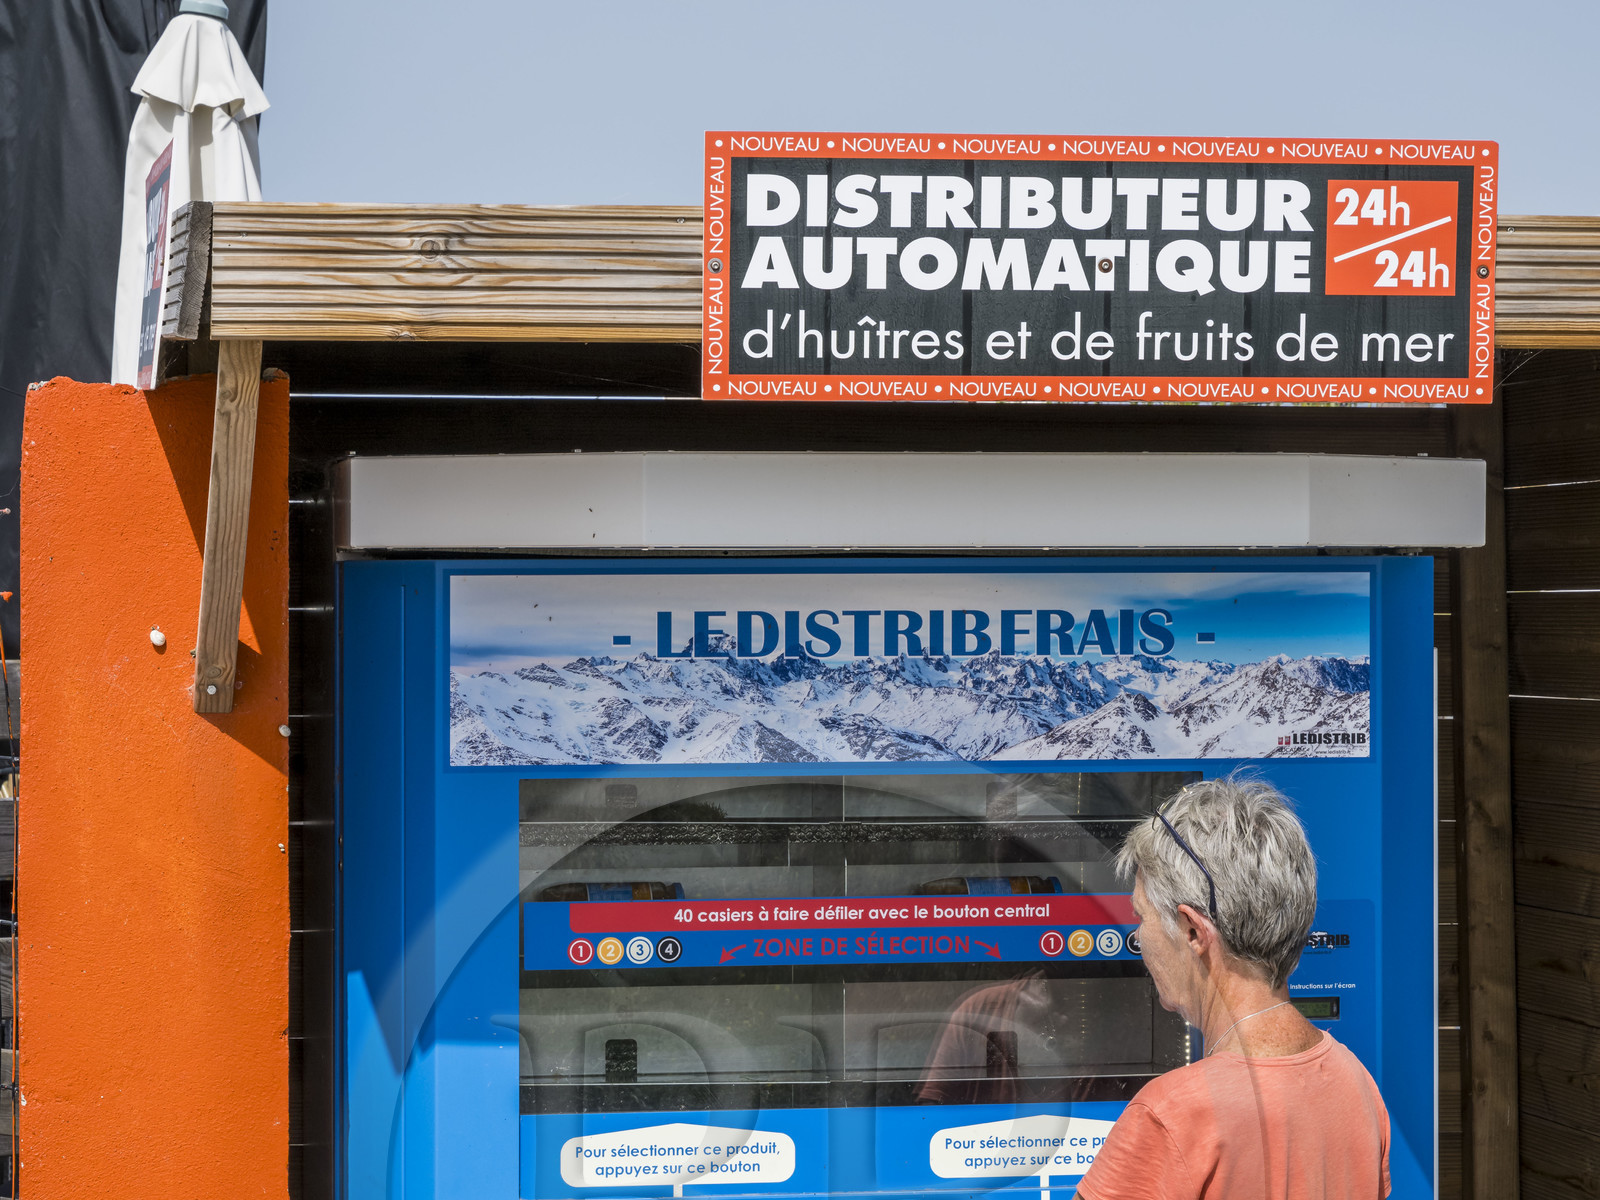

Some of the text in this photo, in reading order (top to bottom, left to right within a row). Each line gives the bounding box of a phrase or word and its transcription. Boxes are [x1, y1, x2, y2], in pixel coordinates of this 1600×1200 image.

[731, 137, 1474, 160] NOUVEAU NOUVEAU NOUVEAU NOUVEAU NOUVEAU NOUVEAU NOUVEAU
[747, 174, 1314, 231] DISTRIBUTEUR
[1334, 187, 1410, 226] 24h
[708, 157, 724, 373] NOUVEAU NOUVEAU
[741, 237, 1311, 296] AUTOMATIQUE
[1374, 248, 1450, 288] 24h
[1476, 166, 1494, 377] NOUVEAU NOUVEAU
[743, 310, 1455, 363] d'huîtres et de fruits de mer
[729, 381, 1468, 398] NOUVEAU NOUVEAU NOUVEAU NOUVEAU NOUVEAU NOUVEAU NOUVEAU
[656, 609, 1175, 658] LEDISTRIBFRAIS
[1293, 733, 1367, 745] LEDISTRIB
[673, 904, 1050, 923] 40 casiers à faire défiler avec le bouton central
[753, 931, 970, 957] ZONE DE SÉLECTION
[576, 1142, 780, 1158] Pour sélectionner ce produit,
[945, 1138, 975, 1149] Pour
[979, 1136, 1065, 1149] sélectionner
[1069, 1137, 1088, 1147] ce
[595, 1160, 761, 1178] appuyez sur ce bouton
[964, 1157, 1026, 1169] appuyez
[1030, 1155, 1050, 1165] sur
[1054, 1155, 1072, 1165] ce
